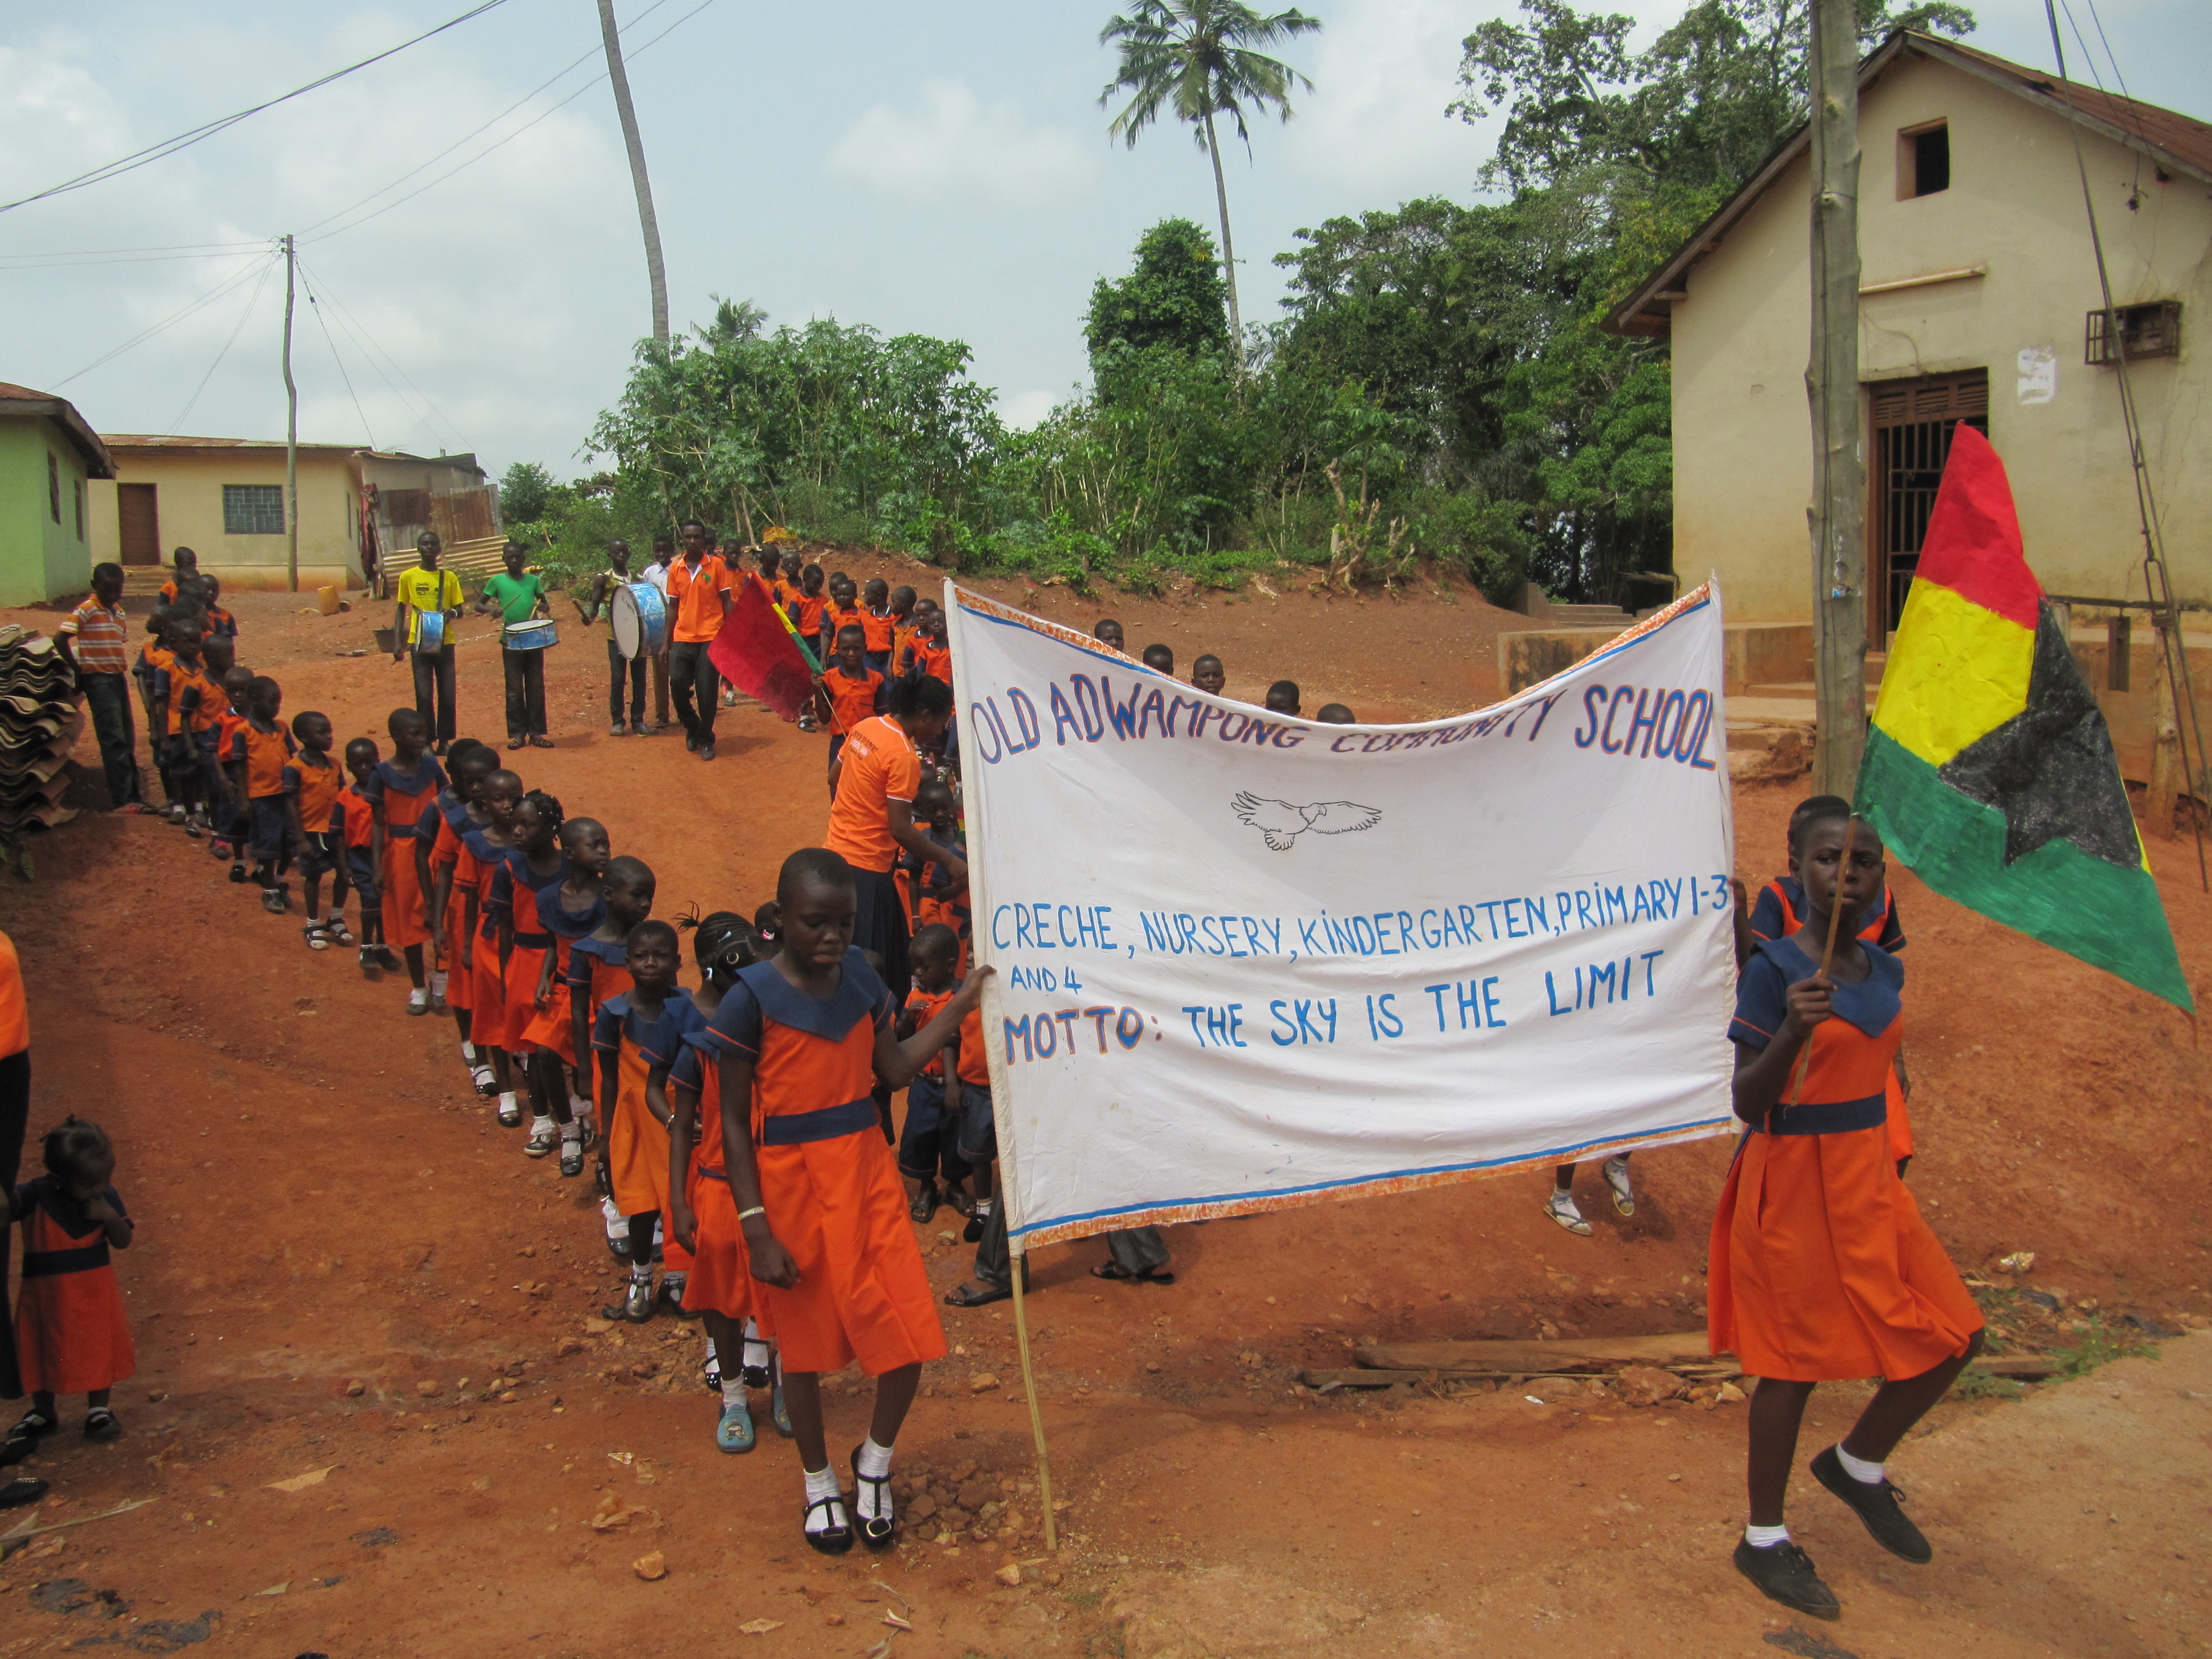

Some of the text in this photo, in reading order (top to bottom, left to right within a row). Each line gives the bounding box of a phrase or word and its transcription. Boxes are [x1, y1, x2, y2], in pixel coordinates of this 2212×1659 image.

[971, 673, 1717, 771] OLD ADWAMPONG COMMUNITY SCHOOL
[1690, 874, 1728, 916] 1-3
[1003, 950, 1665, 1066] MOTTO: THE SKY IS THE LIMIT
[1010, 965, 1083, 995] AND 4
